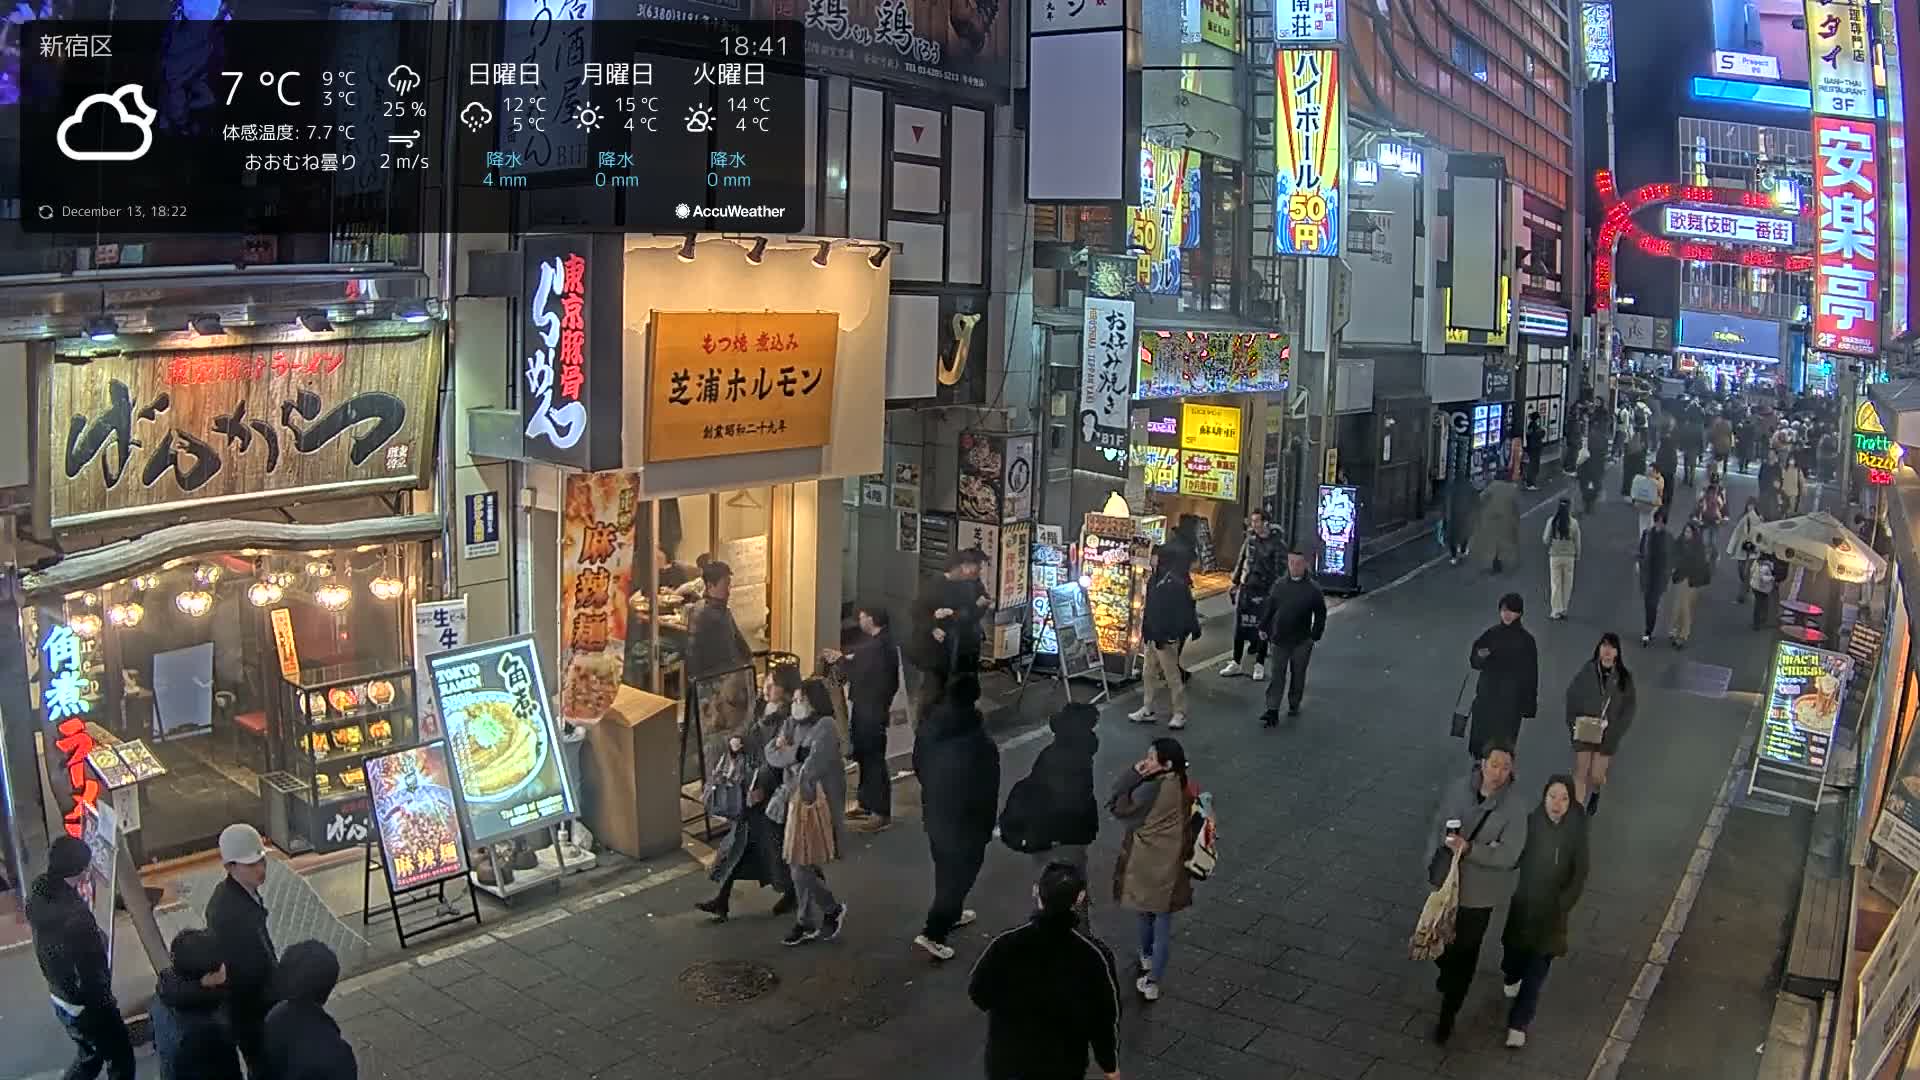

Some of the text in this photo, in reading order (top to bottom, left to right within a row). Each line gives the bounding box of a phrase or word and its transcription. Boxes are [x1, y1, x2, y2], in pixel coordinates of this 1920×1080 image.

[1816, 0, 1842, 71] タイ
[1848, 0, 1866, 63] 理専門店
[1588, 63, 1610, 80] 7F
[1720, 54, 1735, 70] S
[1831, 97, 1855, 112] 3F
[1295, 54, 1322, 190] ハイボール
[1159, 150, 1178, 290] ハイボール
[1288, 195, 1327, 222] 50
[1295, 223, 1320, 250] 円
[1669, 211, 1789, 242] 歌舞伎町一番街
[1818, 125, 1876, 330] 安楽亭
[559, 252, 586, 400] 東京豚骨
[1817, 332, 1837, 348] 2F
[756, 331, 799, 353] 煮込み
[1101, 310, 1128, 414] お好み焼き
[668, 366, 823, 406] 芝浦ホルモン
[65, 378, 407, 491] ばんから
[702, 419, 788, 440] 創業昭和二十九年
[1101, 433, 1125, 445] B1F
